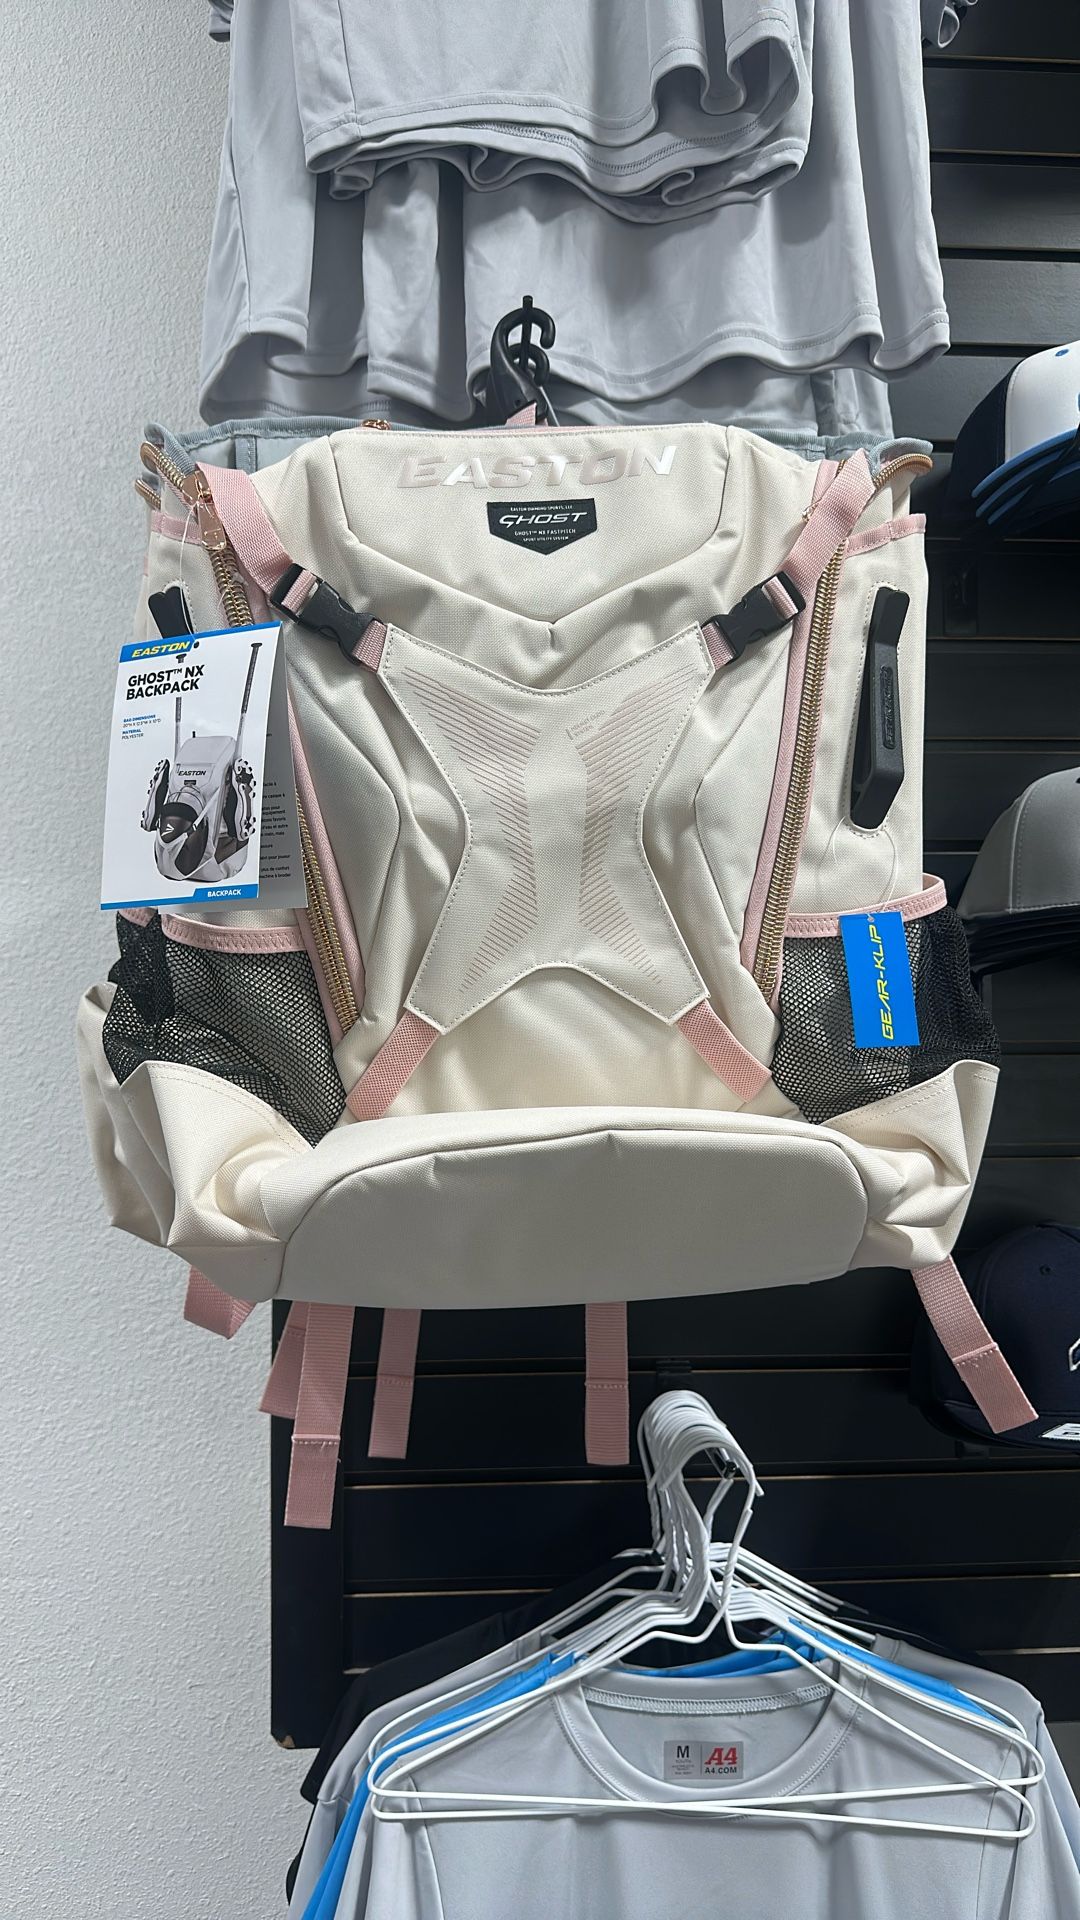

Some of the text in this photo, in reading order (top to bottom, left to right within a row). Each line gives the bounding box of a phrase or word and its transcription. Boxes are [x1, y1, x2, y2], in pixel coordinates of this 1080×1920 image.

[397, 445, 678, 489] EASTON
[499, 511, 588, 528] GHOST
[132, 642, 190, 658] EASTON
[184, 664, 205, 679] NX
[126, 678, 200, 700] BACKPACK
[207, 889, 242, 898] BACKPACK
[868, 924, 895, 1040] GEAR-KLIP
[677, 1746, 738, 1765] M A4
